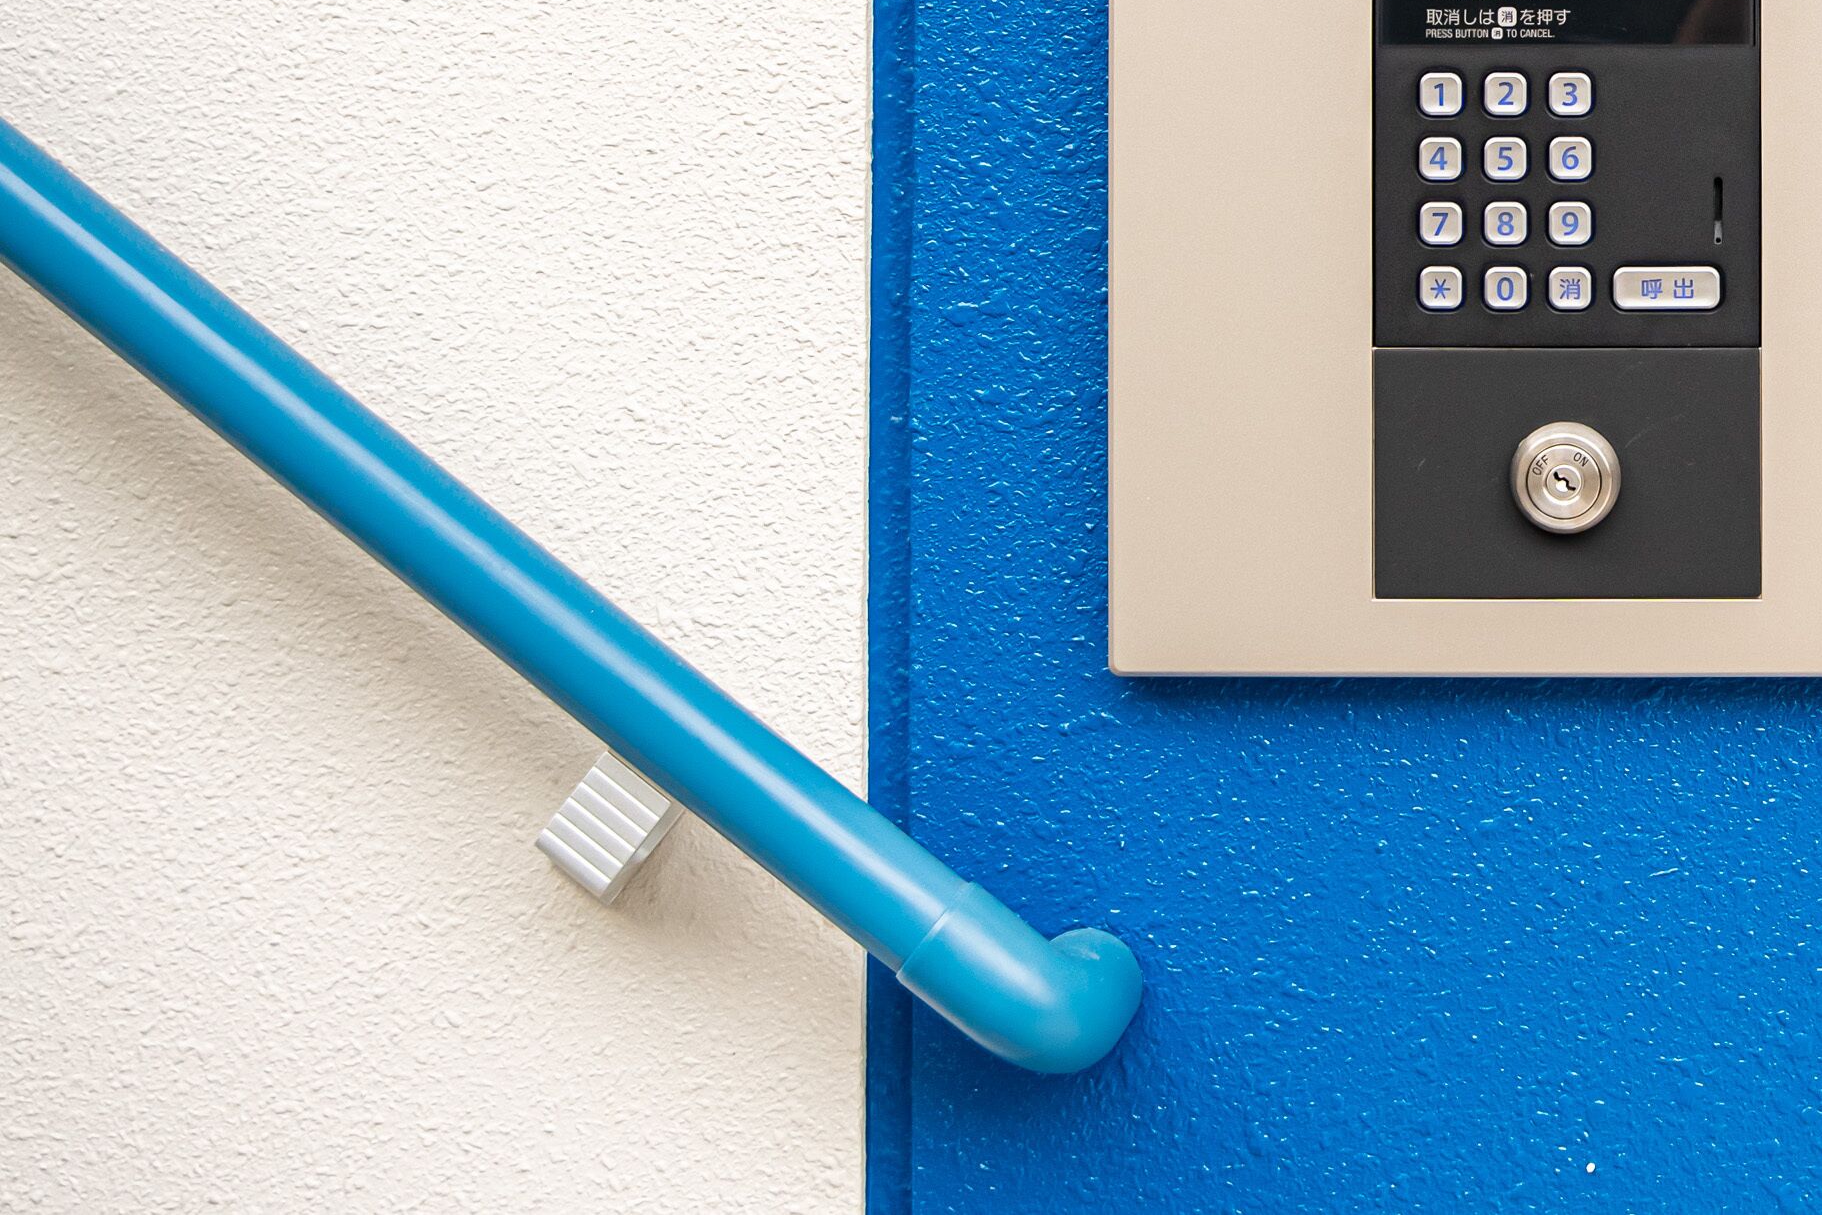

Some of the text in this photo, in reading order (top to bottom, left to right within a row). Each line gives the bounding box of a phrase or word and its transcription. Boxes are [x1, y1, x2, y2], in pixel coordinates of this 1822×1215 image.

[1425, 29, 1454, 38] PRESS
[1455, 29, 1489, 38] BUTTON
[1506, 29, 1519, 38] TO
[1519, 29, 1556, 38] CANCEL.
[1433, 81, 1578, 106] 1 2 3
[1429, 146, 1580, 170] 4 5 6
[1431, 211, 1579, 236] 7 8 9
[1496, 277, 1514, 301] 0
[1559, 278, 1581, 300] 消
[1532, 454, 1550, 476] OFF
[1573, 452, 1590, 467] ON
